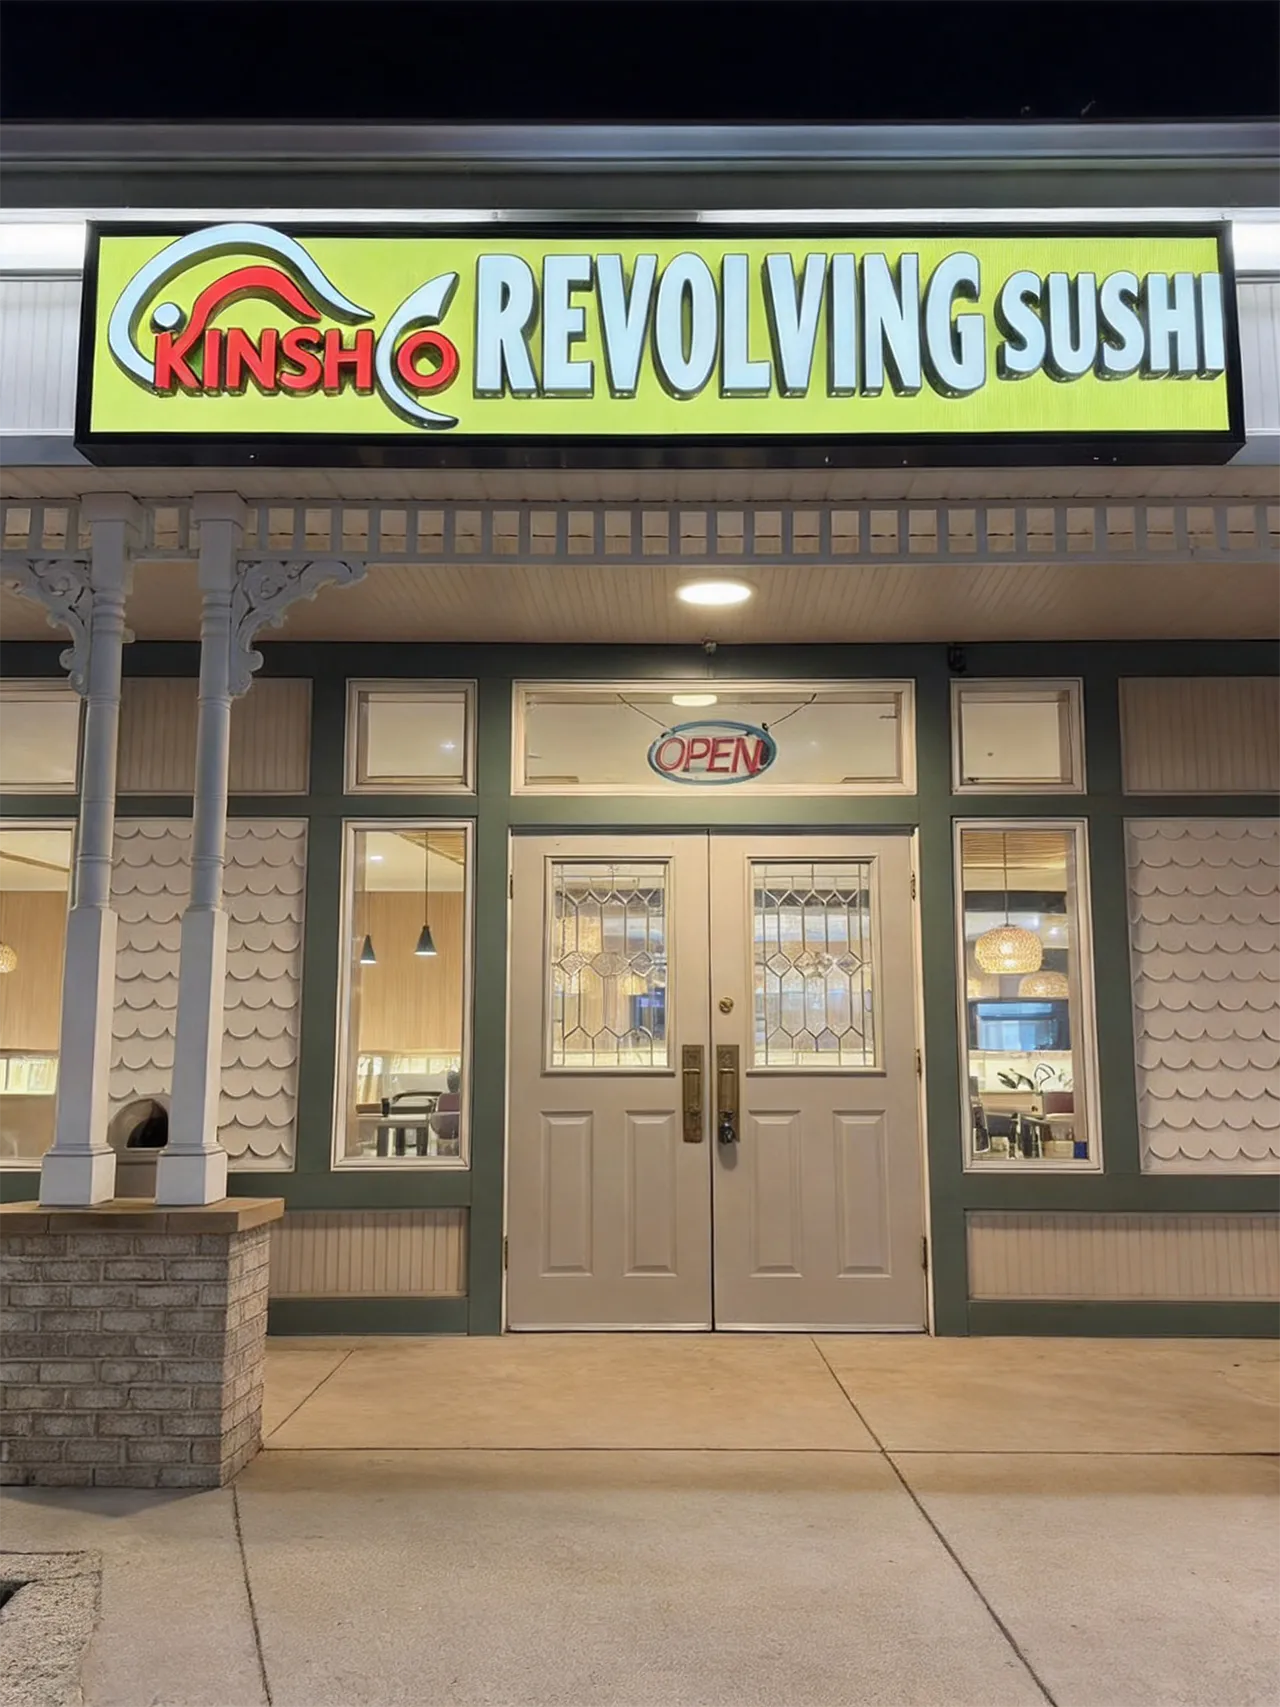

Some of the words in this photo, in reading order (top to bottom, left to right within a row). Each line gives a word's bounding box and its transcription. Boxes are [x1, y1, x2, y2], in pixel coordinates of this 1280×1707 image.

[473, 252, 986, 400] REVOLVING
[997, 270, 1226, 383] SUSHI
[655, 737, 764, 775] OPEN
